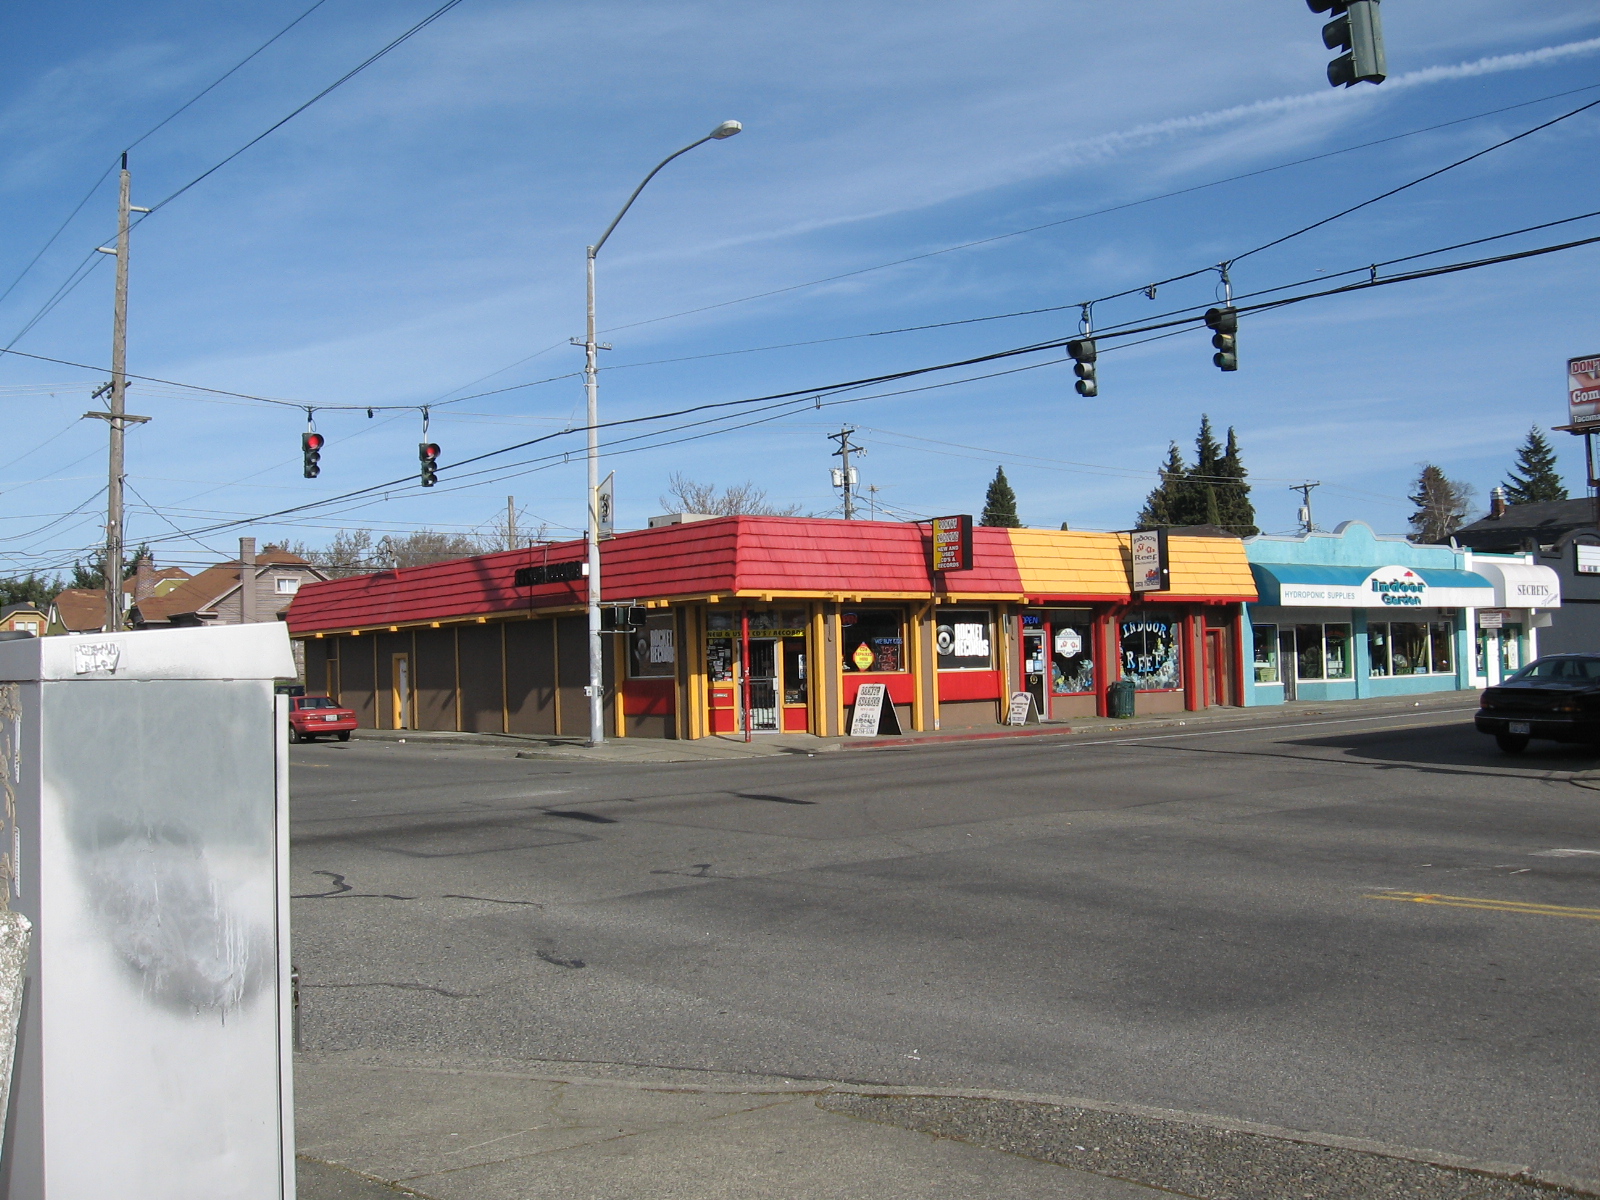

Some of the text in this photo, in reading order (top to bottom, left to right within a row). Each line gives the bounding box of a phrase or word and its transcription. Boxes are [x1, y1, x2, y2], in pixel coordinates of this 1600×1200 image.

[1371, 578, 1426, 593] Indoor
[1518, 584, 1548, 596] SECRETS
[1284, 590, 1355, 600] HYDROPONIC SUPPLIES
[1381, 593, 1421, 605] Garden
[954, 624, 983, 640] ROCKET
[1123, 621, 1167, 638] INDOOR
[954, 639, 989, 656] RECORDS
[1126, 650, 1162, 672] REEF
